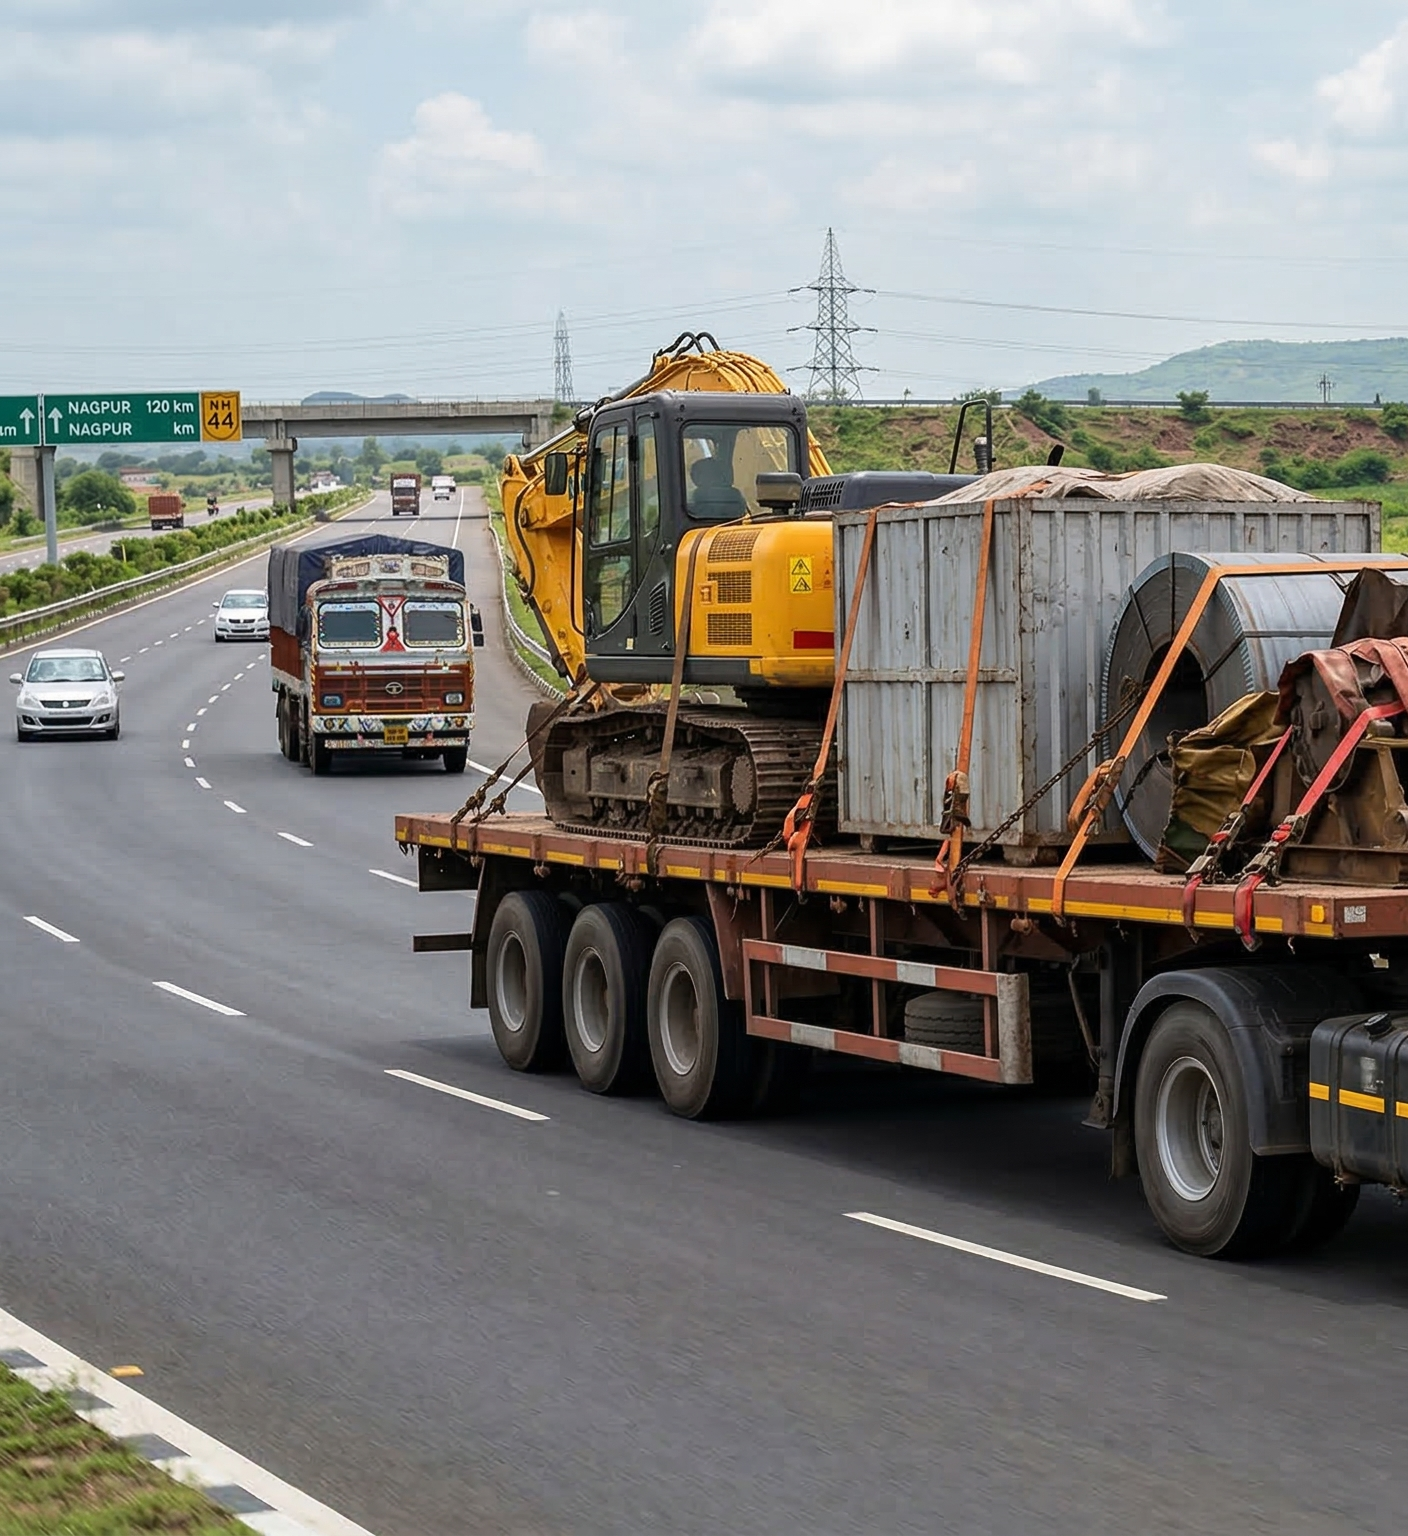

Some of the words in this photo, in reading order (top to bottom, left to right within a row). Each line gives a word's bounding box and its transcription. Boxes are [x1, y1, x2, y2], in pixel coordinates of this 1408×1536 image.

[68, 400, 131, 414] NAGPUR
[146, 400, 169, 413] 120
[173, 400, 194, 413] km
[210, 400, 231, 410] NH
[207, 412, 233, 429] 44
[69, 422, 132, 436] NAGPUR
[173, 422, 194, 434] km
